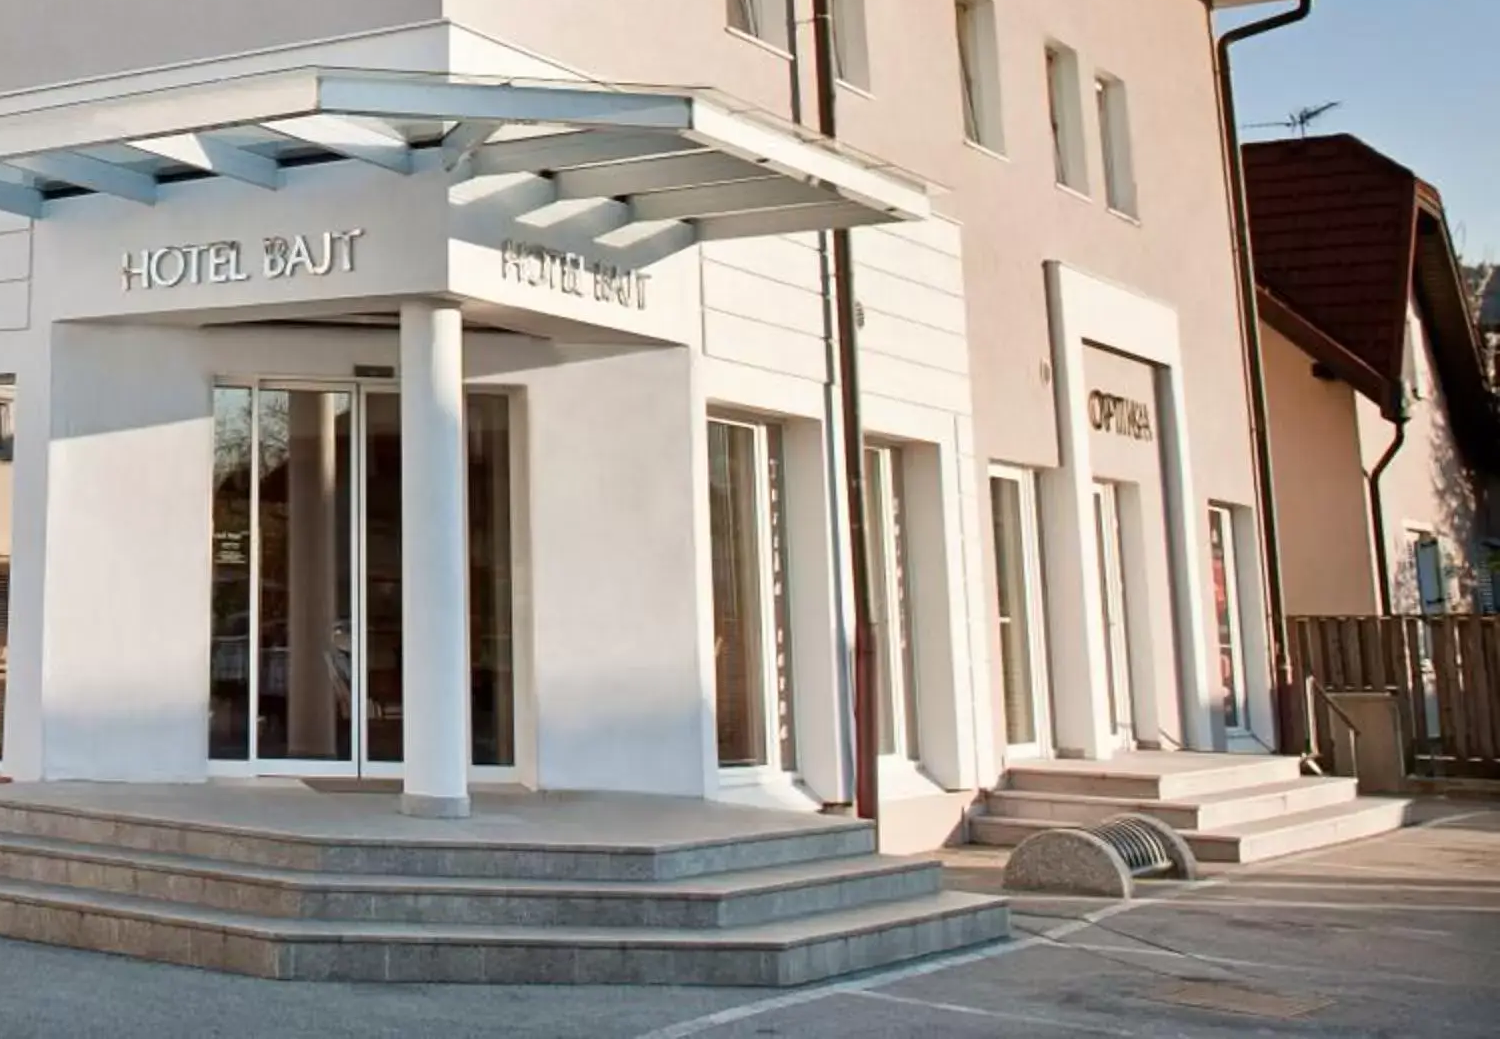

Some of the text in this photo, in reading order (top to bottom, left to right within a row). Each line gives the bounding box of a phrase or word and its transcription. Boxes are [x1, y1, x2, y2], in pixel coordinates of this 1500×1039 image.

[121, 227, 365, 291] HOTEL BAJT
[501, 239, 652, 310] HOTEL BAJT
[1088, 389, 1153, 442] OPTIKA
